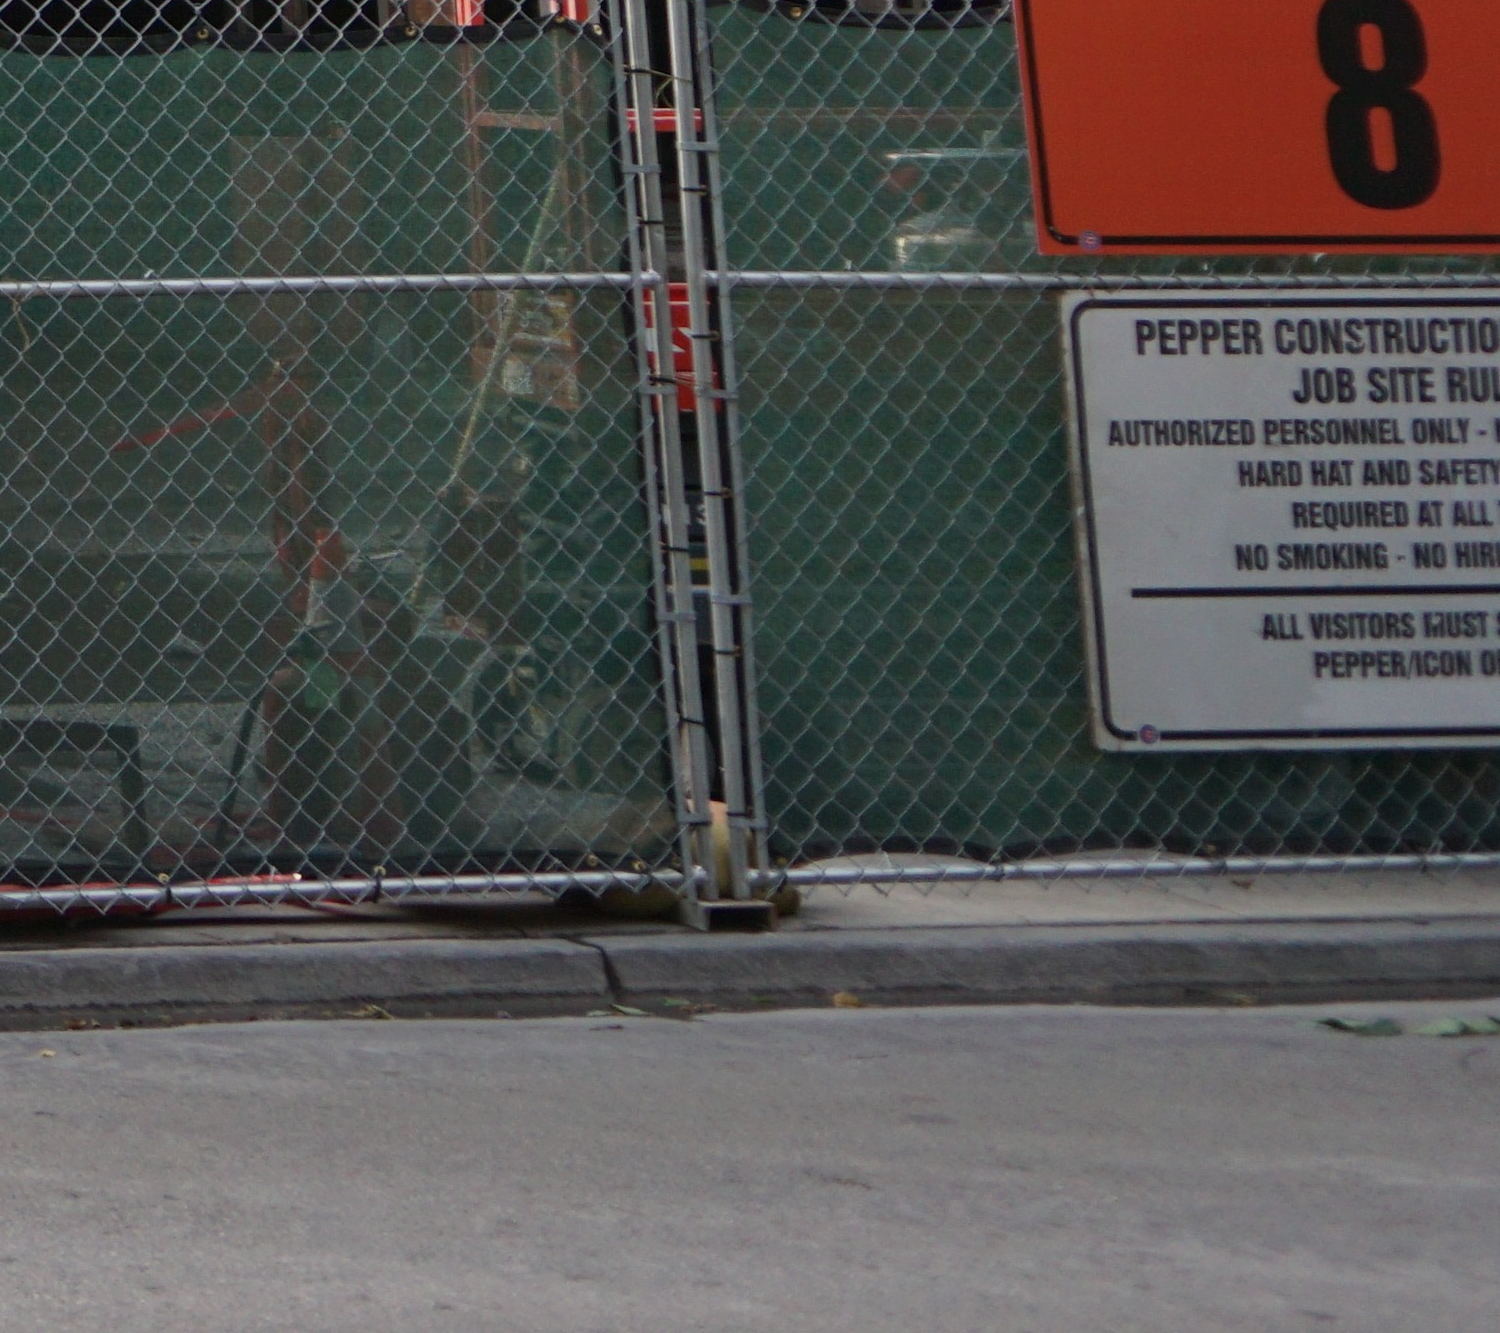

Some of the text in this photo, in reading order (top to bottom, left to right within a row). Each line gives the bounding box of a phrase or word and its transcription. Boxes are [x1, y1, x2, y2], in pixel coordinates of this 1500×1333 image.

[1135, 319, 1264, 355] PEPPER
[1293, 367, 1357, 404] JOB
[1367, 366, 1437, 403] SITE
[1108, 418, 1256, 447] AUTHORIZED
[1263, 418, 1406, 446] PERSONNEL
[1411, 417, 1470, 444] ONLY
[1237, 460, 1303, 487] HARD
[1310, 460, 1355, 486] HAT
[1362, 459, 1412, 486] AND
[1292, 500, 1493, 531] REQUIRED AT ALL
[1235, 544, 1269, 571] NO
[1276, 542, 1389, 571] SMOKING
[1413, 542, 1448, 569] NO
[1262, 611, 1489, 640] ALL VISITORS MUST
[1313, 649, 1473, 679] PEPPER/ICON
